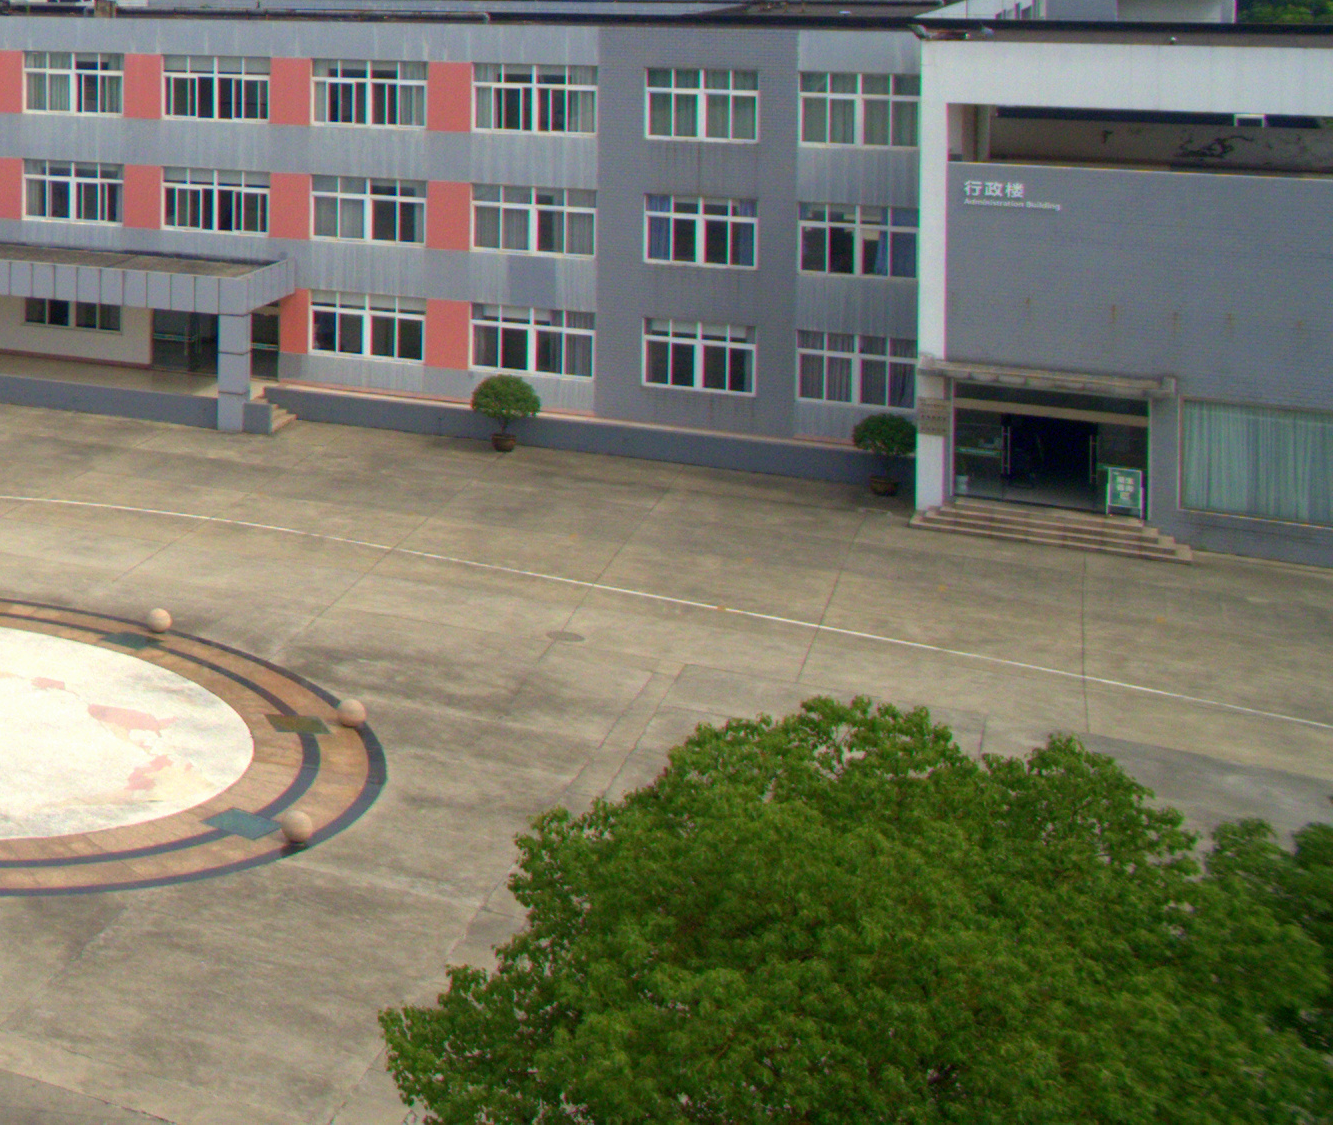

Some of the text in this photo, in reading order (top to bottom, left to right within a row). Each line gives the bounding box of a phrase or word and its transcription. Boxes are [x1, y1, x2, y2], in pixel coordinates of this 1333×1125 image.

[964, 180, 1024, 198] 行政楼
[964, 197, 1061, 211] Administration Building
